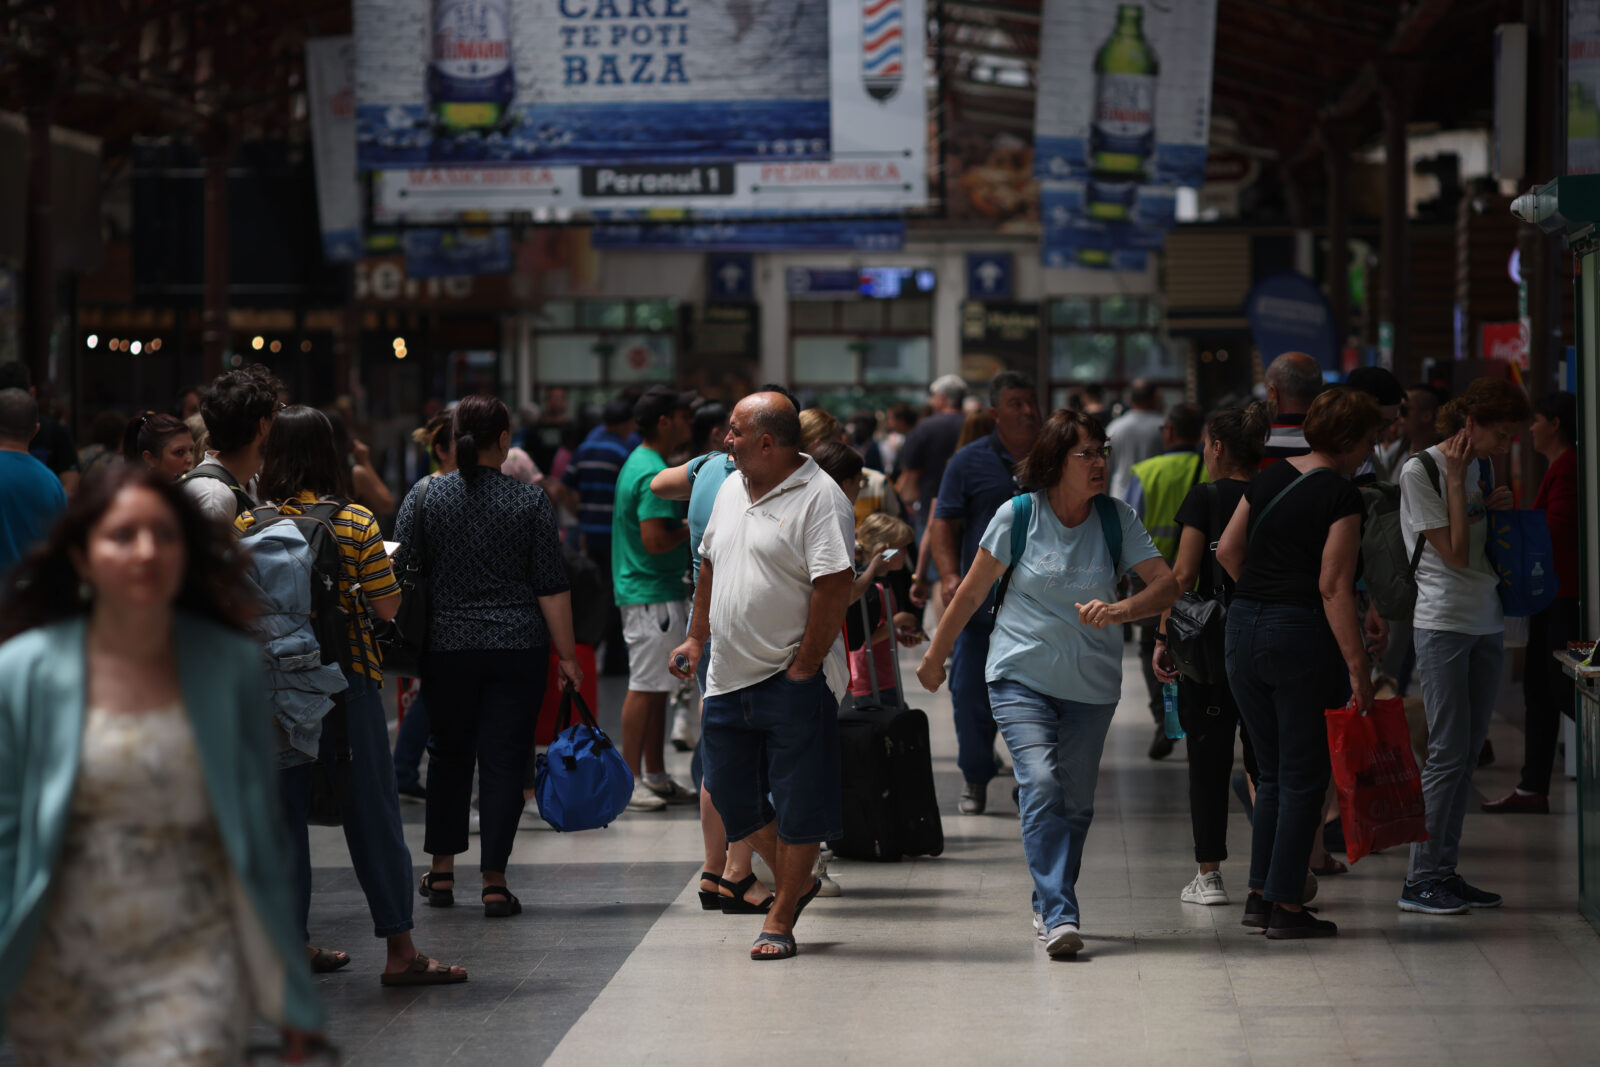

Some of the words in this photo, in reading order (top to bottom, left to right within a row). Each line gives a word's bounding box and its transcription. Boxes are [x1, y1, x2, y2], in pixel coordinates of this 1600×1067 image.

[558, 0, 689, 19] CARE
[560, 25, 600, 47] TE
[562, 53, 690, 86] BAZA
[596, 167, 702, 194] Peronul
[707, 167, 720, 192] 1
